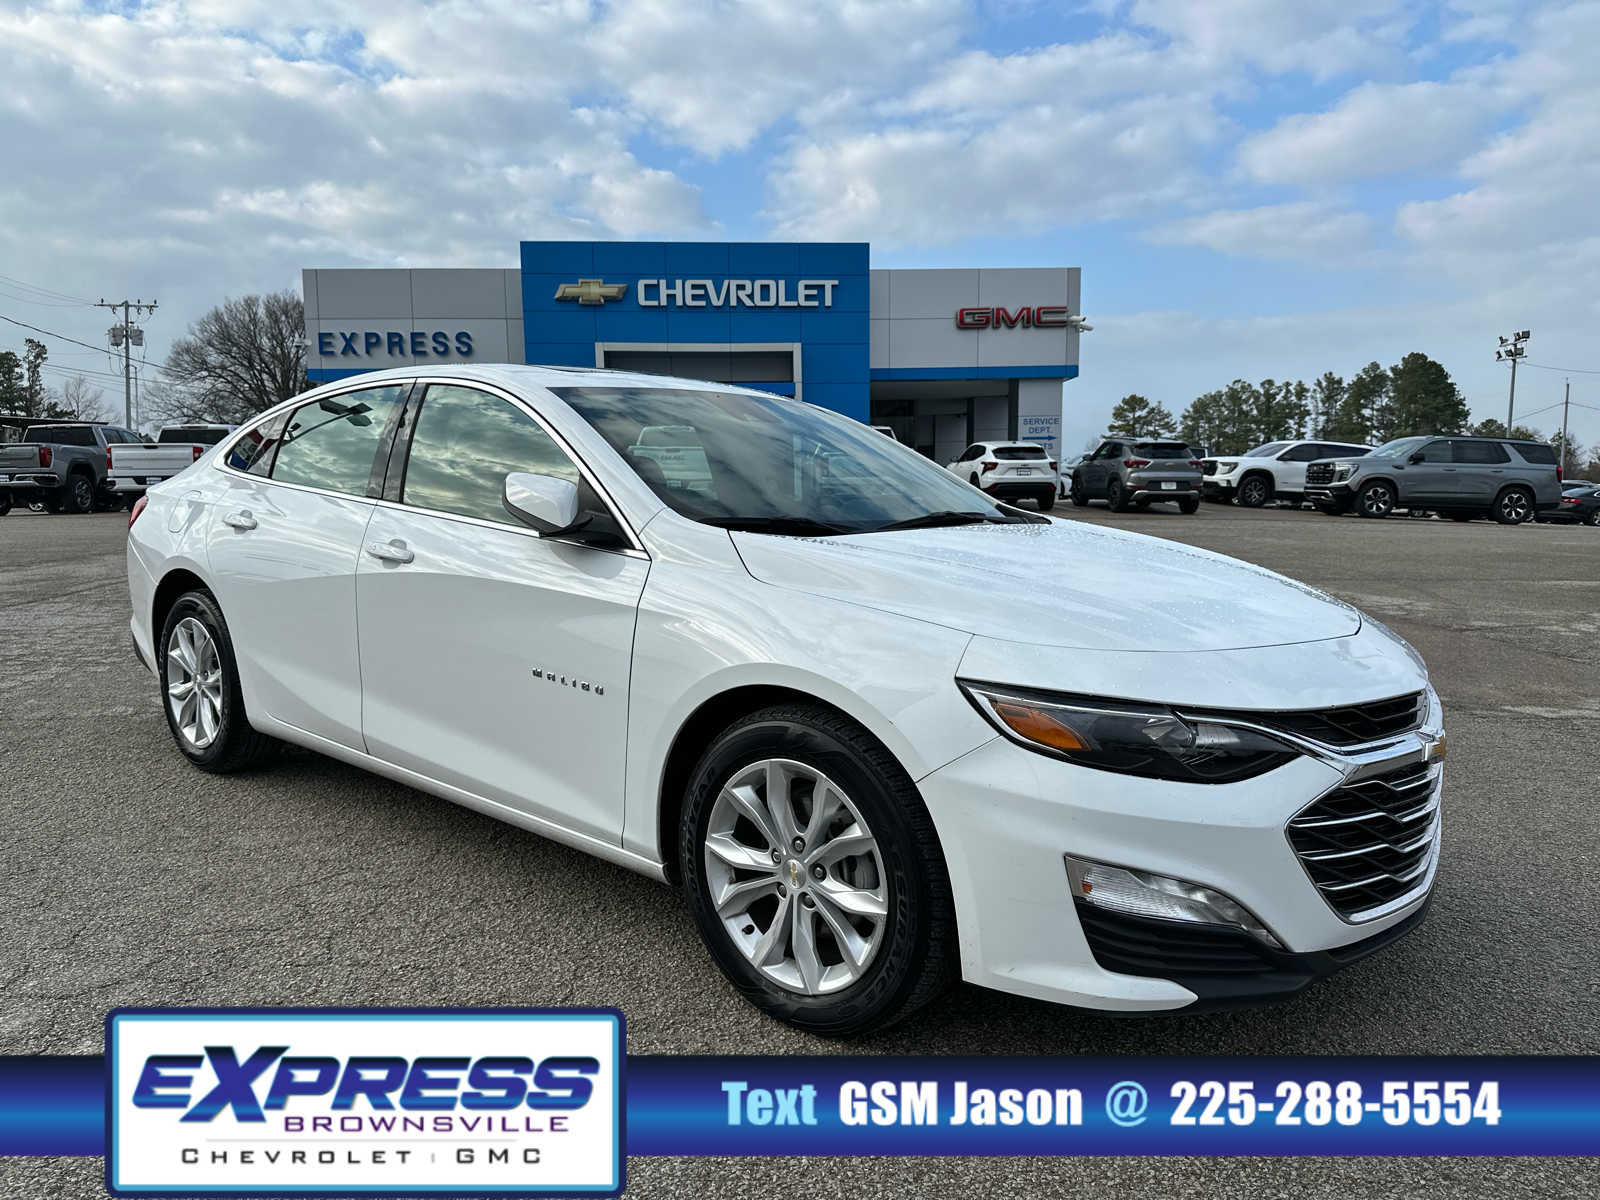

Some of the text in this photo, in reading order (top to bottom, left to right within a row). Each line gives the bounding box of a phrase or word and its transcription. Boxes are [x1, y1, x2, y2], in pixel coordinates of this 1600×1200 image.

[637, 279, 839, 308] CHEVROLET
[956, 306, 1068, 329] GMC
[318, 331, 474, 356] EXPRESS
[1023, 417, 1059, 425] SERVICE
[532, 667, 604, 695] MALIBU
